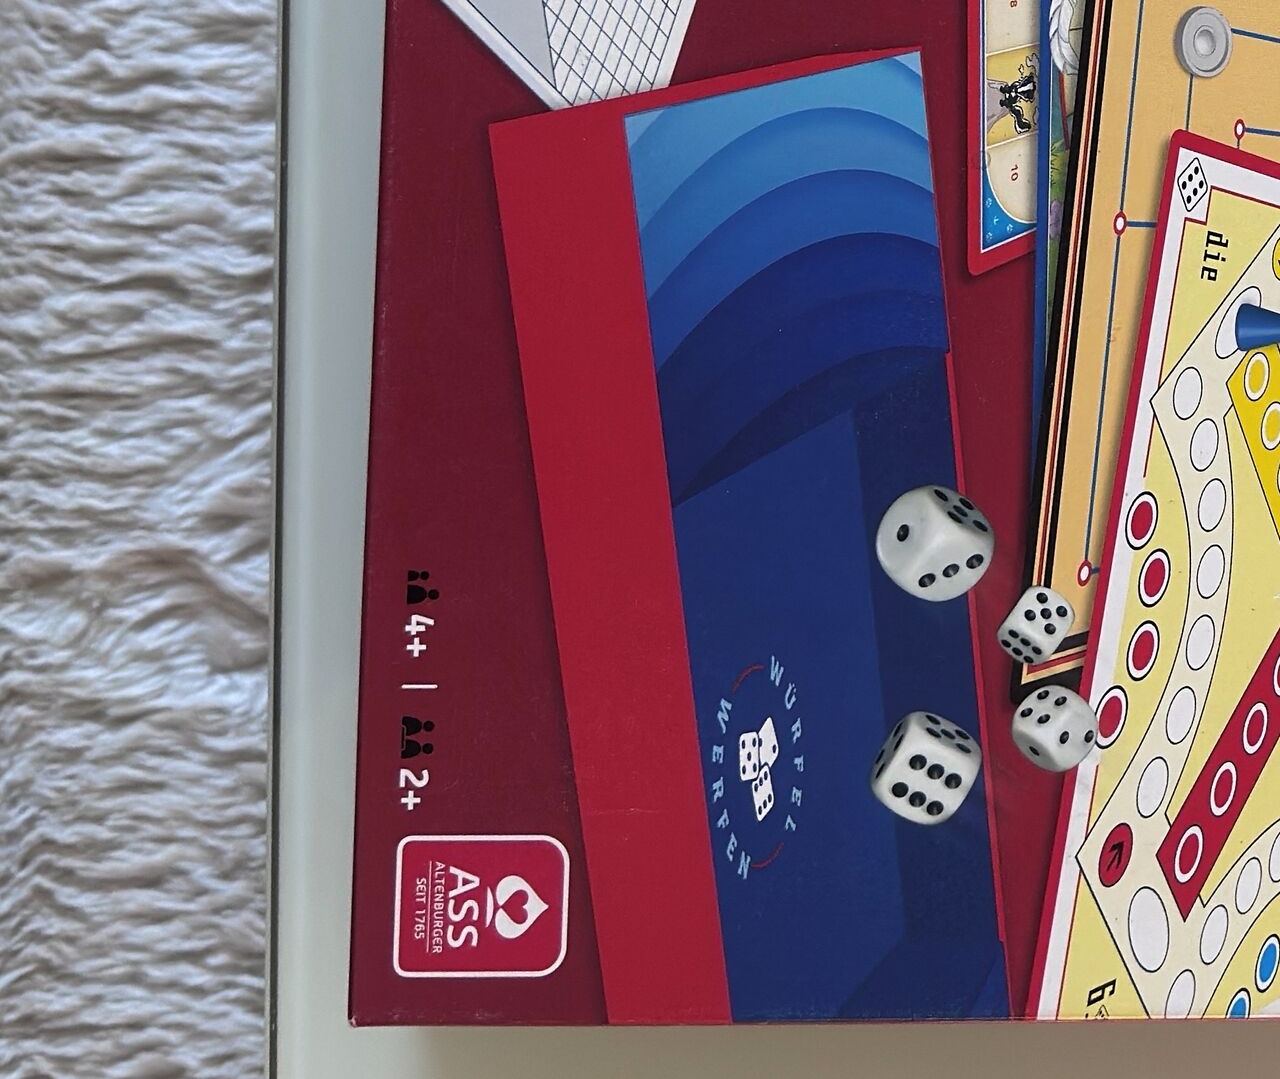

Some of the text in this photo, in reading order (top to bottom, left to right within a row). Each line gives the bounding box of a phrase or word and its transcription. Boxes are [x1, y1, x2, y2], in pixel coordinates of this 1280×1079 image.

[1201, 230, 1229, 282] die
[405, 614, 435, 658] 4+
[399, 769, 430, 811] 2+
[414, 877, 427, 940] SEIT 1765
[431, 860, 446, 954] ALTENBURGER
[447, 864, 480, 949] ASS
